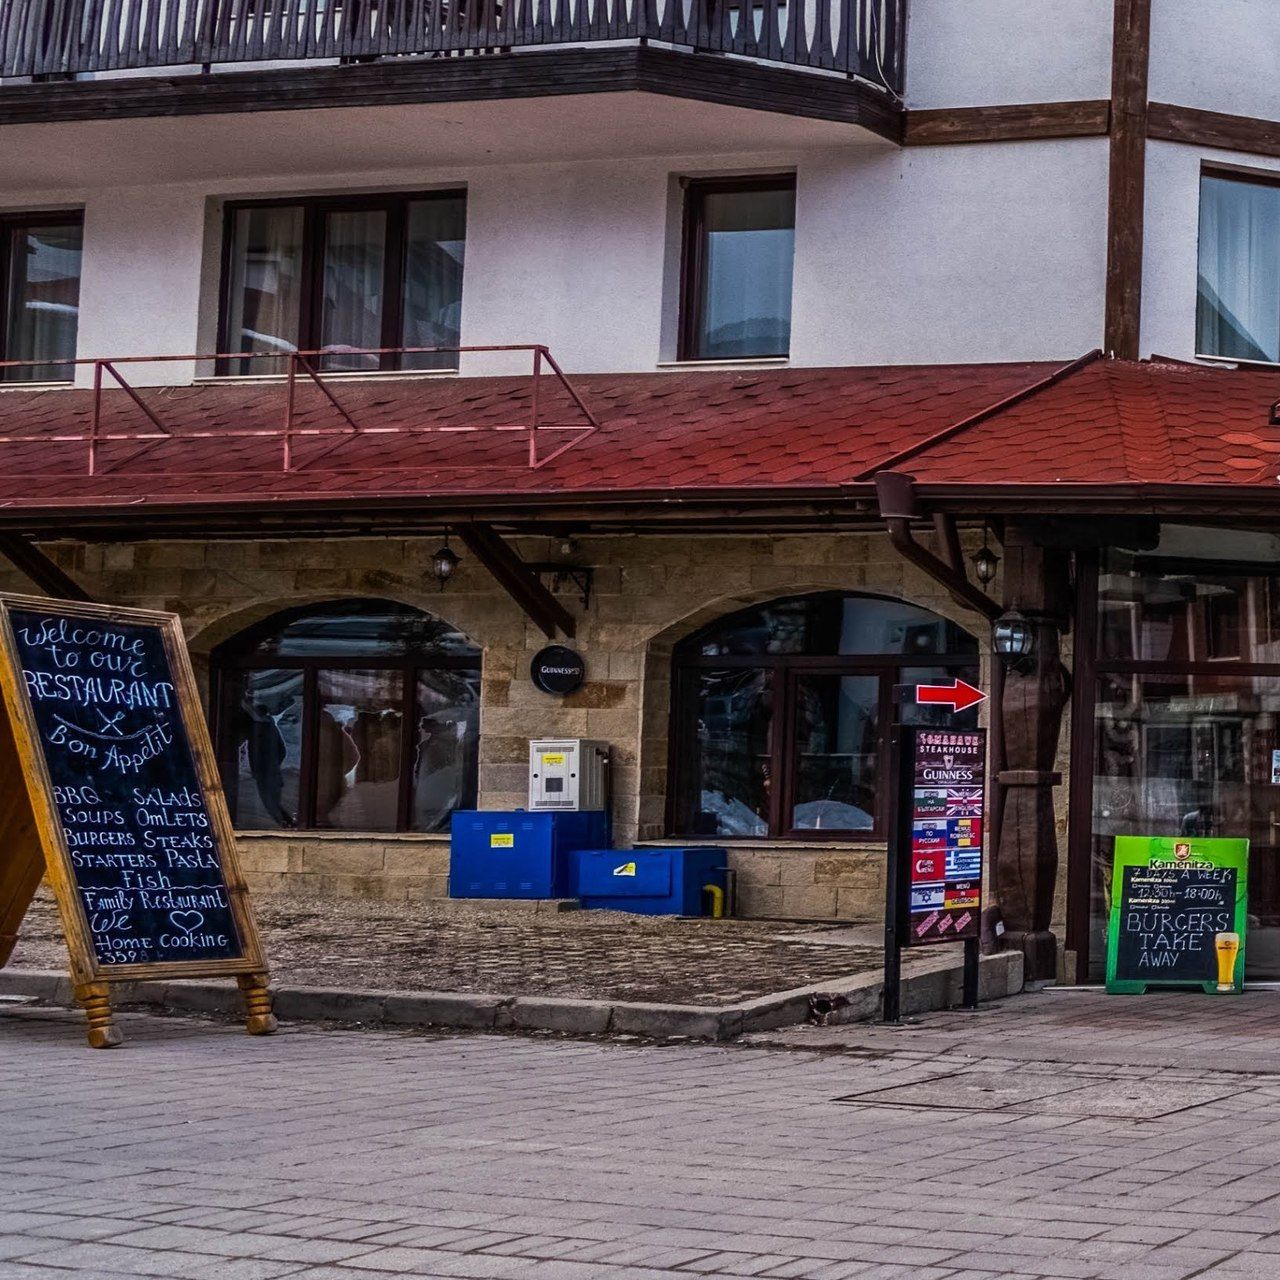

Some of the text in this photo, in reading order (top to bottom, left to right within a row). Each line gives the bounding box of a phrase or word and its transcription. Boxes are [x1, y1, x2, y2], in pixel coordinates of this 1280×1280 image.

[18, 618, 147, 657] Welcome
[44, 644, 149, 678] to our
[22, 669, 175, 710] RESTAURANT
[51, 724, 98, 759] Bon
[920, 746, 978, 754] STEAKHOUSE
[923, 768, 973, 780] GUINNESS
[53, 786, 103, 805] BBQ
[1150, 859, 1213, 870] Kamenitza
[1181, 869, 1190, 879] A
[121, 870, 172, 889] Fish
[90, 909, 133, 933] We
[1126, 912, 1230, 933] BURGERS
[1139, 933, 1203, 951] TAKE
[1138, 951, 1180, 968] AWAY
